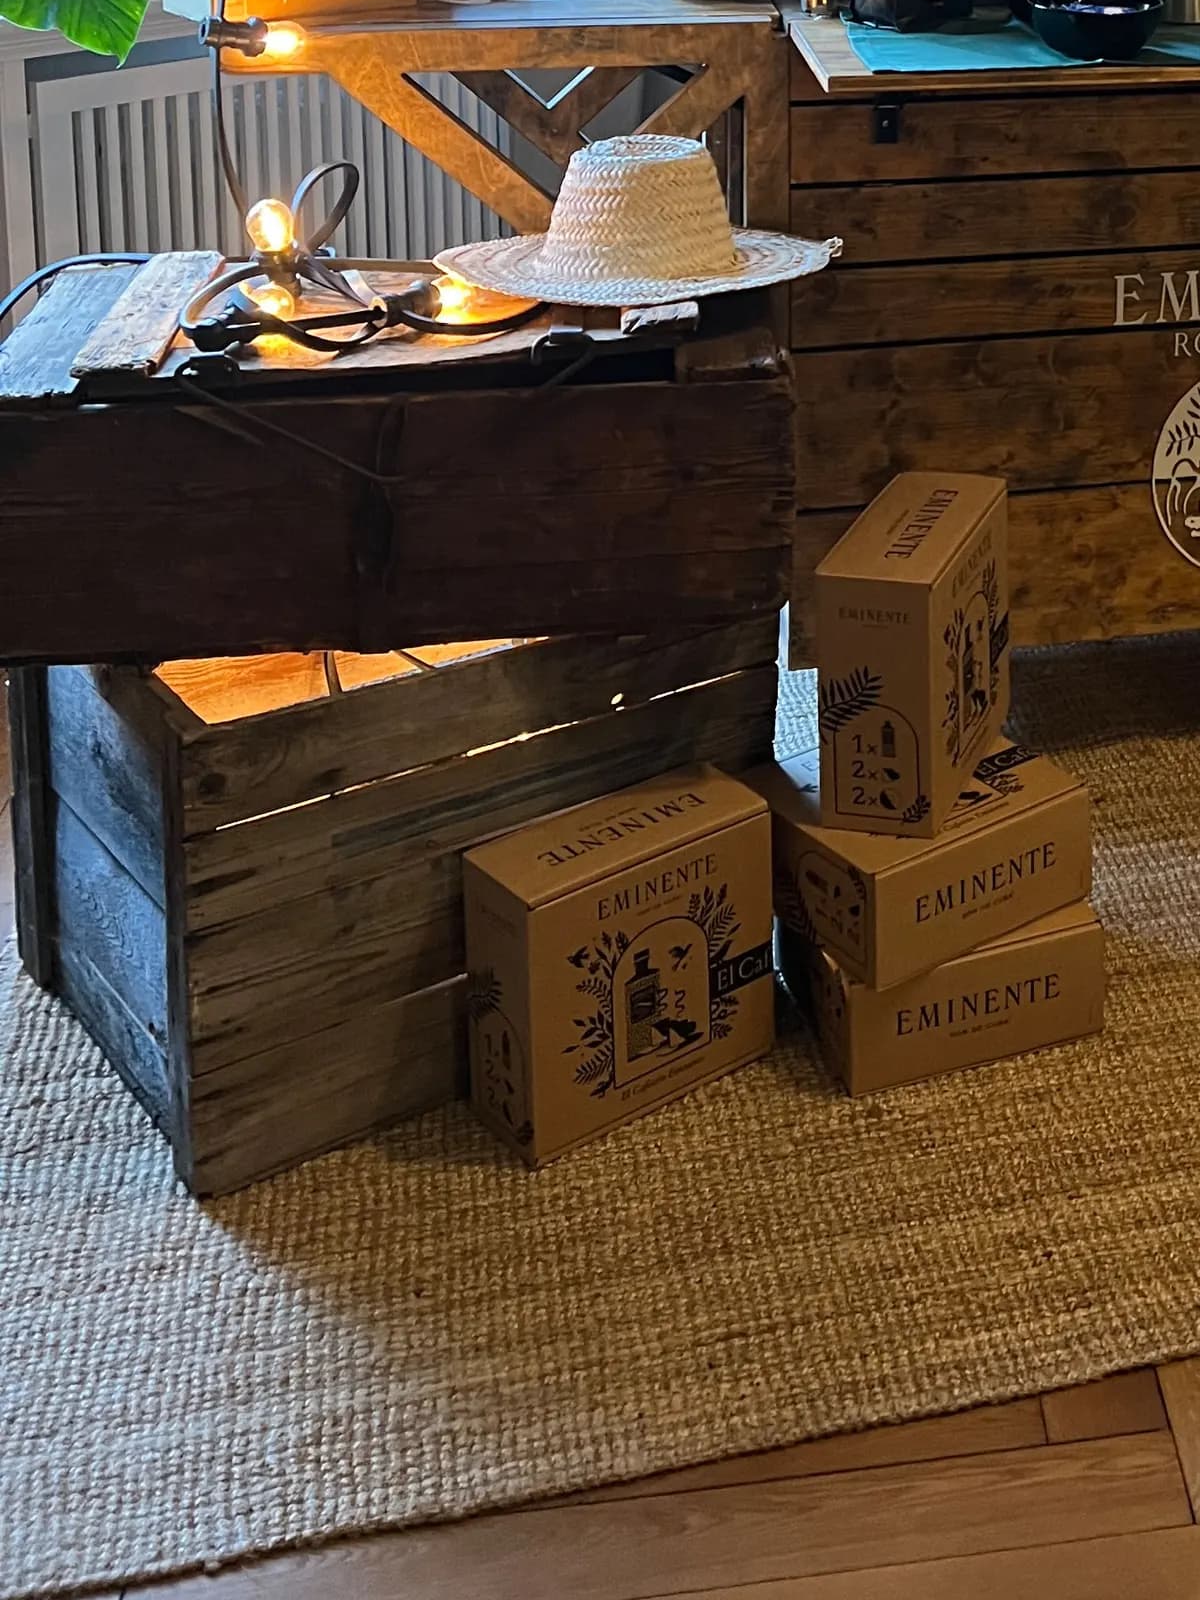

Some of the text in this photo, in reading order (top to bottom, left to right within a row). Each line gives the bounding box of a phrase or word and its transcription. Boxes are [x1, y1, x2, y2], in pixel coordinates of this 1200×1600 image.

[883, 488, 960, 560] EMINENTE
[851, 760, 878, 781] 2x
[852, 786, 878, 806] 2x
[537, 792, 707, 868] EMINENTE
[596, 853, 719, 921] EMINENTE
[915, 841, 1057, 923] EMINENTE
[718, 963, 734, 991] El
[895, 972, 1062, 1037] EMINENTE
